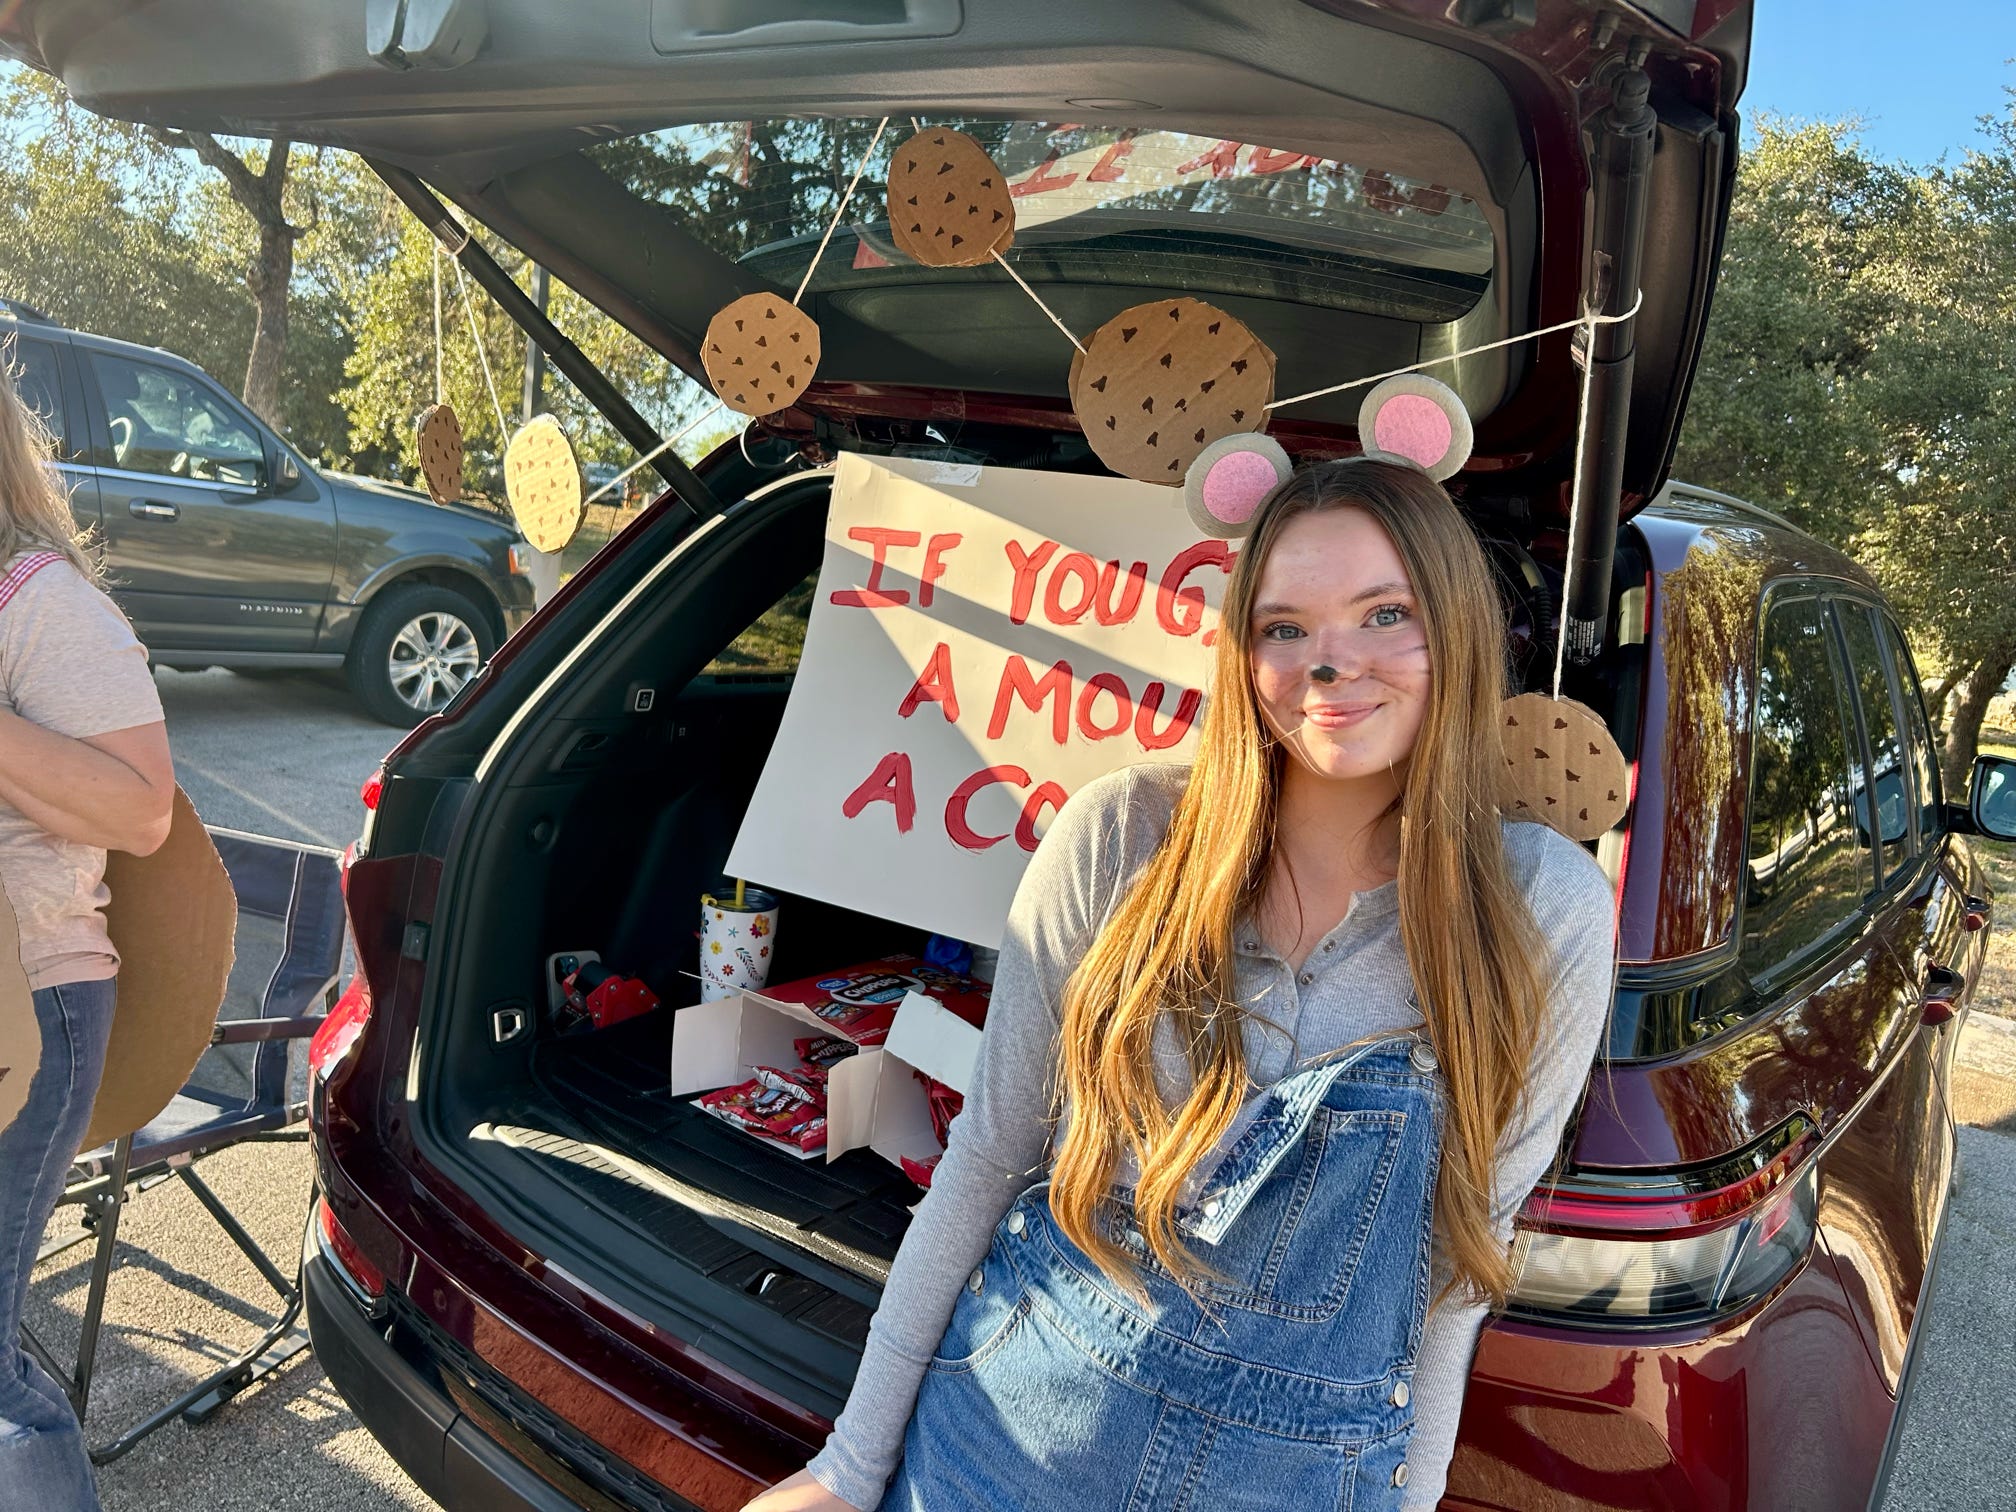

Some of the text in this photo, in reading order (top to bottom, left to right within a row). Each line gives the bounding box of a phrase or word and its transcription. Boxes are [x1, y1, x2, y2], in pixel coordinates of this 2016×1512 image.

[240, 604, 303, 615] PLATINUM
[830, 526, 1239, 646] IF YOU G
[898, 642, 960, 723] A
[842, 752, 916, 835] A
[843, 977, 900, 998] CHIPPERS
